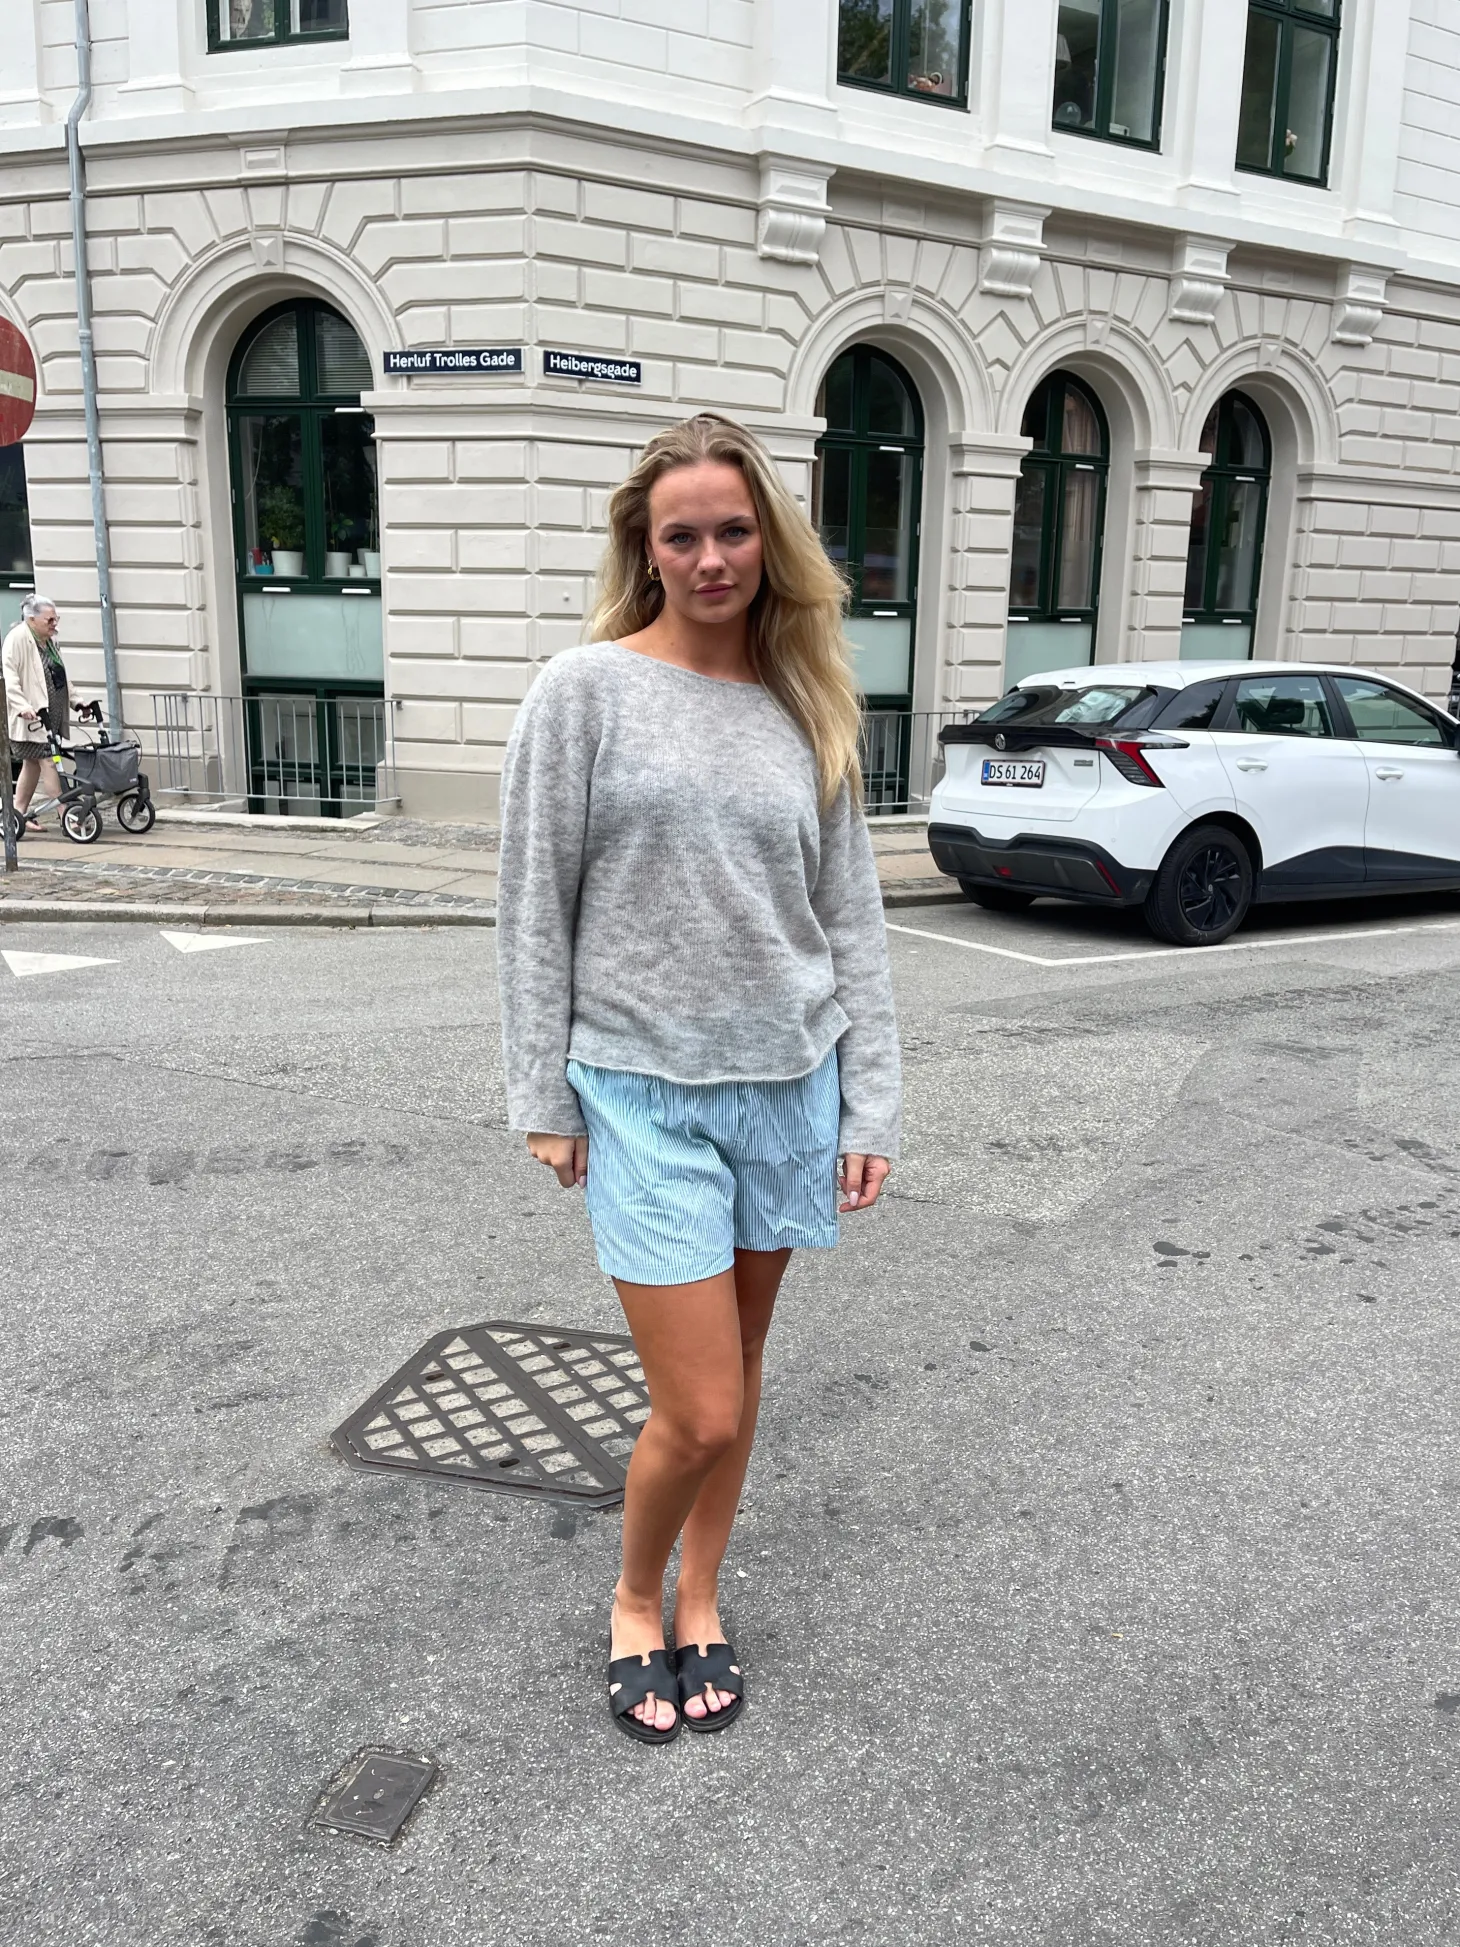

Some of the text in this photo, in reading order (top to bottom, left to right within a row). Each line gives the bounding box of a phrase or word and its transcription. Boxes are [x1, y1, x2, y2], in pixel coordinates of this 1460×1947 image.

[390, 351, 515, 368] Herluf Trolles Gade
[550, 354, 637, 379] Heibergsgade
[989, 764, 1041, 780] DS 61 264
